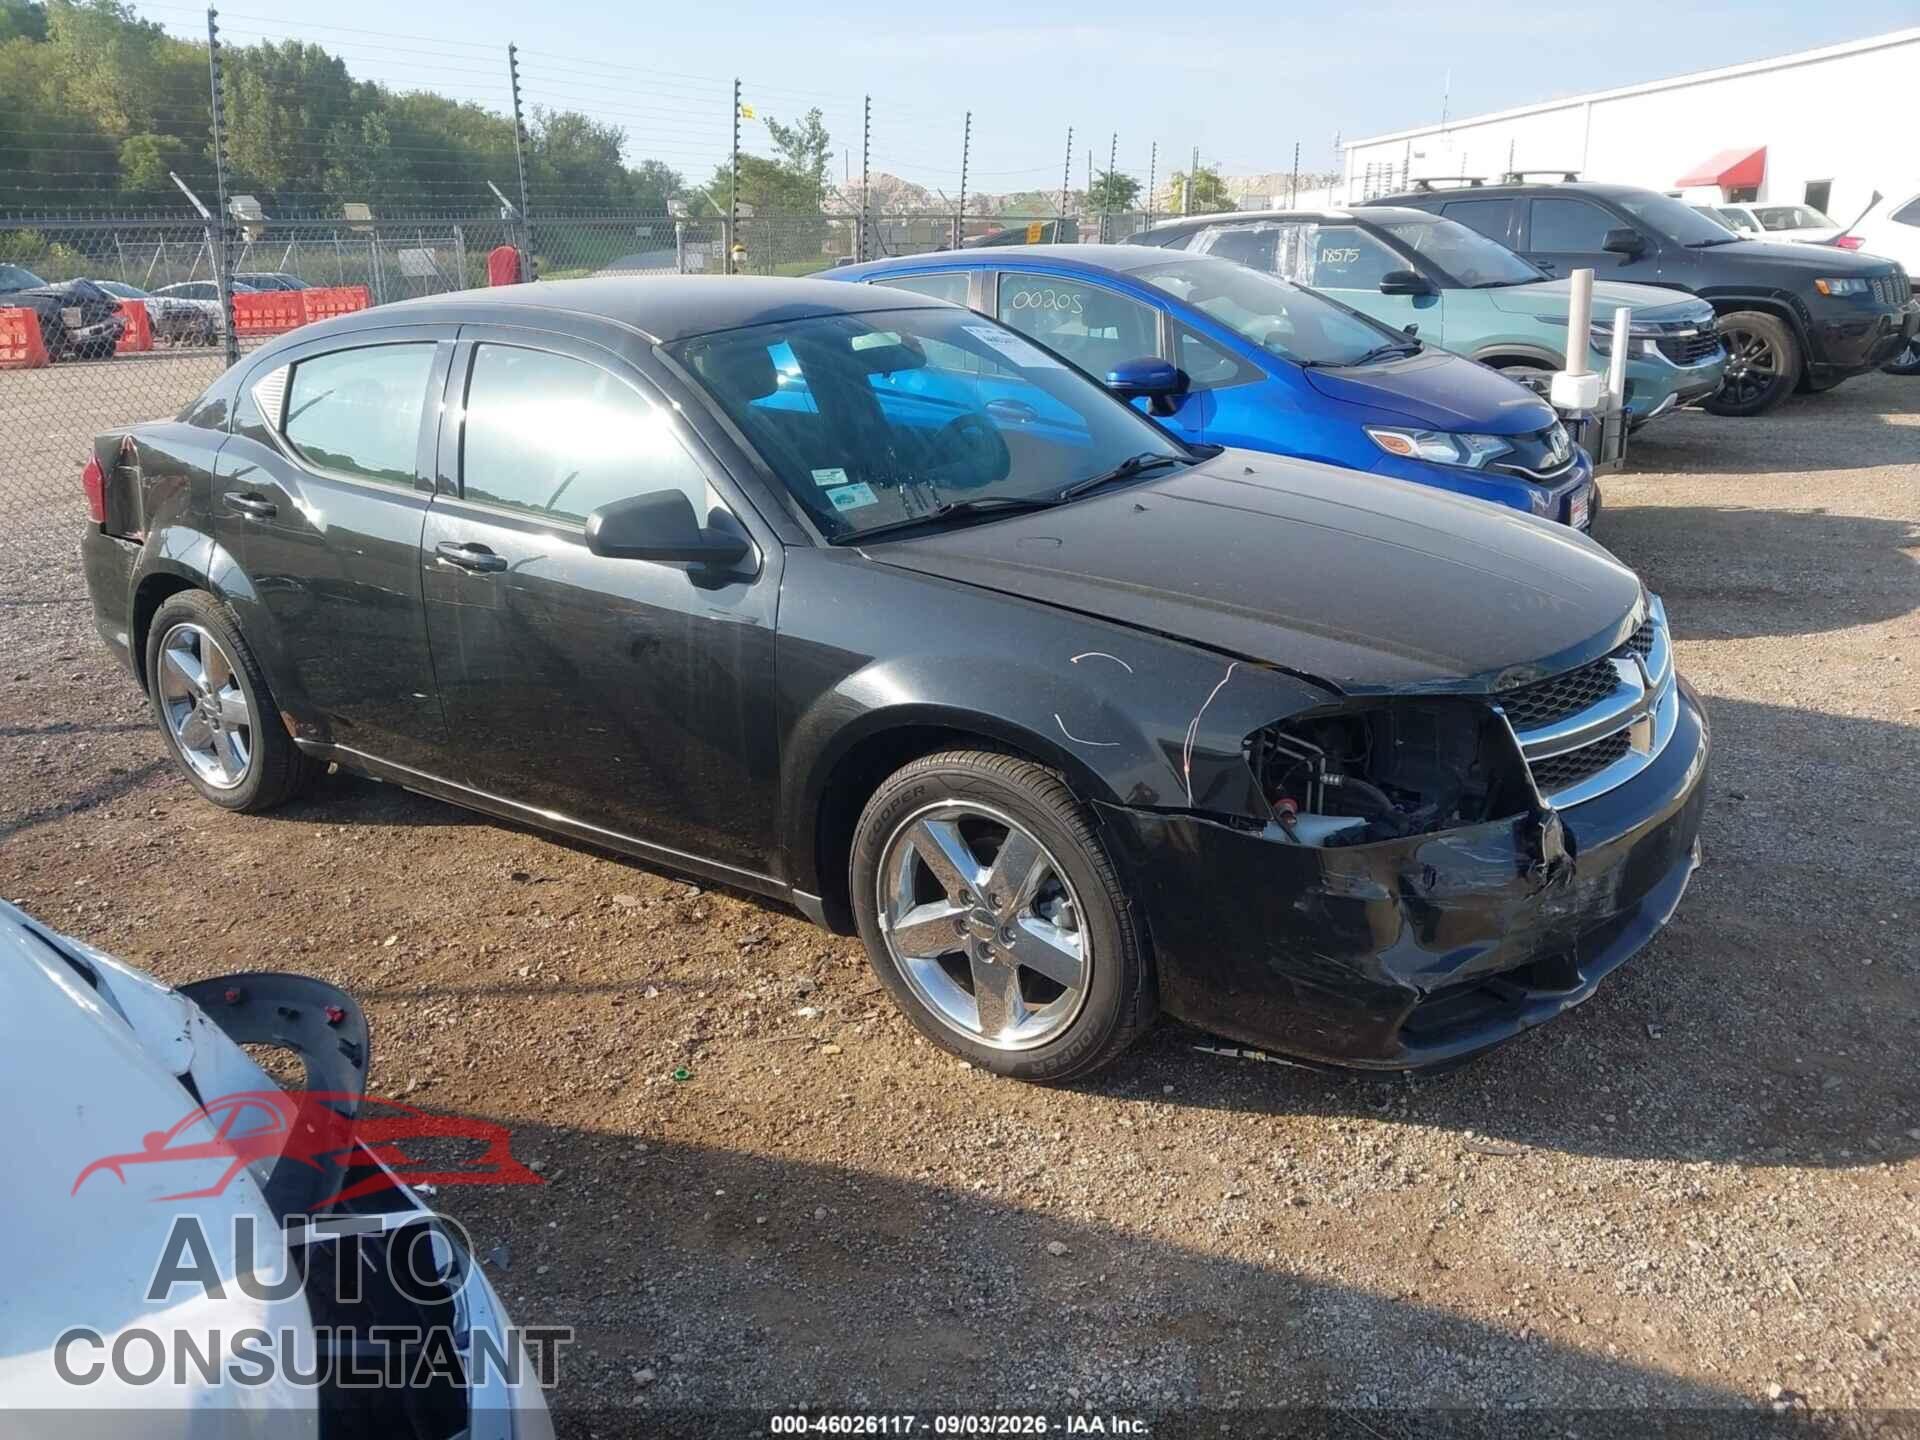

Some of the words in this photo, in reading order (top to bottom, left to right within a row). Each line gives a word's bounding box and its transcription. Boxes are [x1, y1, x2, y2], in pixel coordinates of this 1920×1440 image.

[1322, 247, 1361, 264] 18575
[1012, 288, 1083, 314] 00205
[866, 785, 925, 847] COOPER
